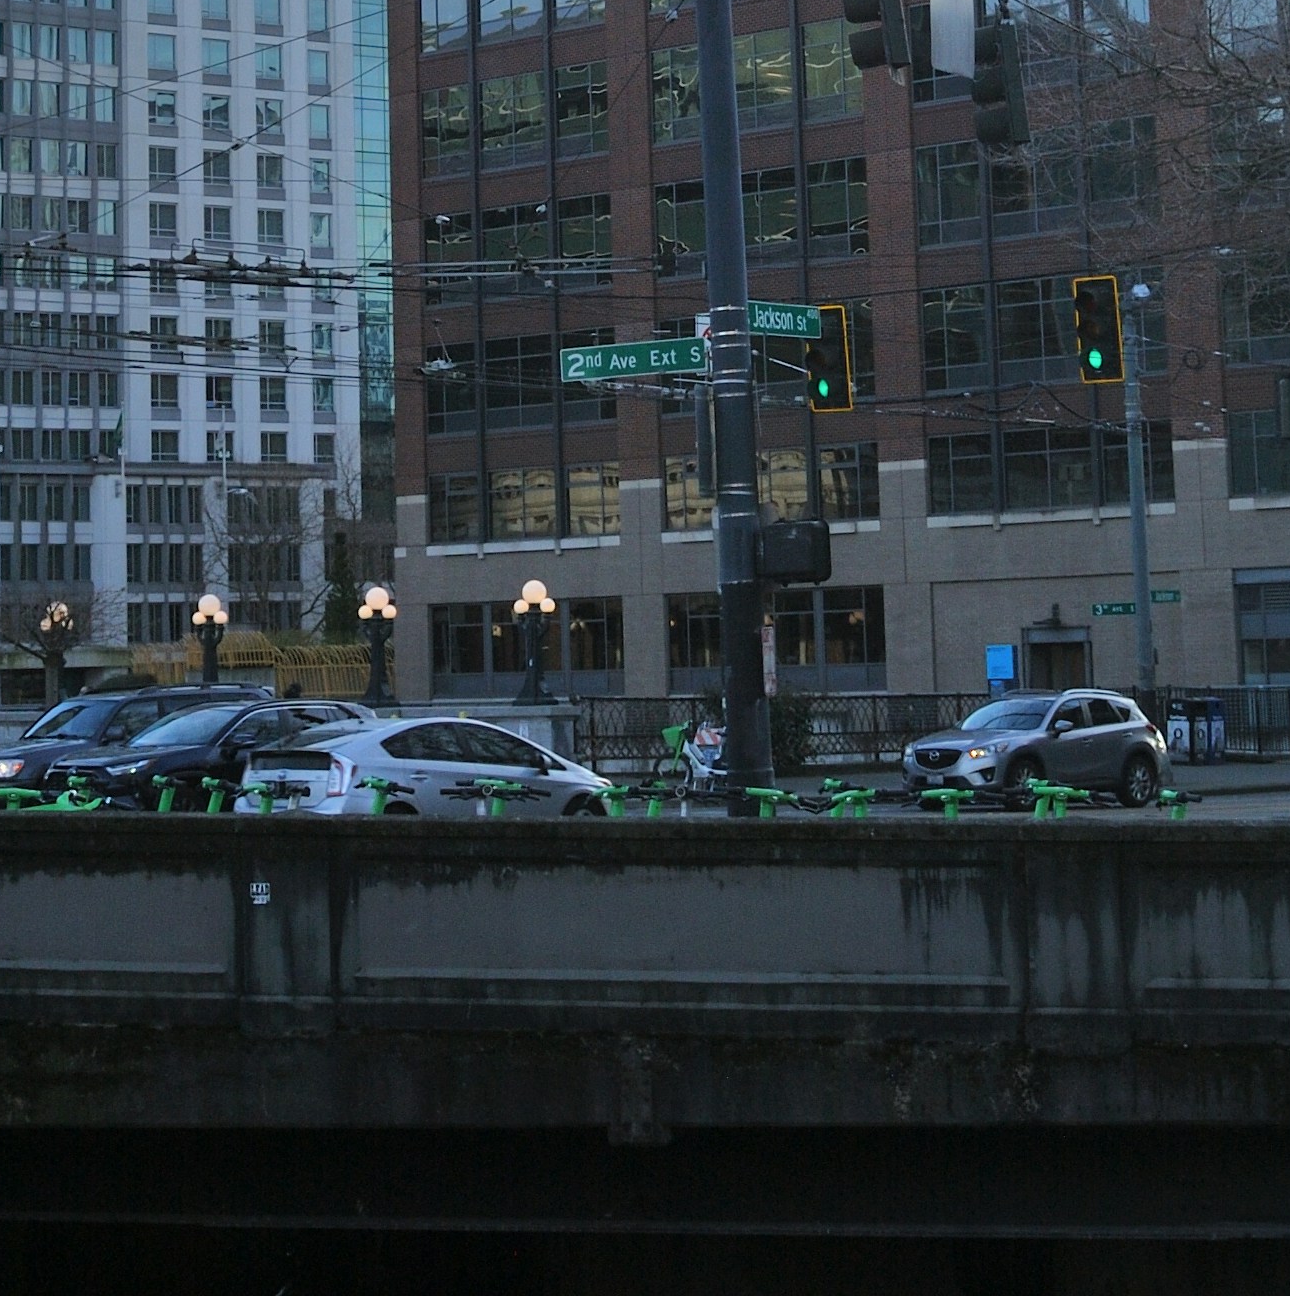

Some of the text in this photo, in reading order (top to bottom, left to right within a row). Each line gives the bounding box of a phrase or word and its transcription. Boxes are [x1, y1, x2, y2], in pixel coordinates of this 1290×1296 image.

[752, 304, 794, 330] Jackson
[796, 315, 808, 332] St
[567, 346, 701, 378] 2nd Ave Ext S
